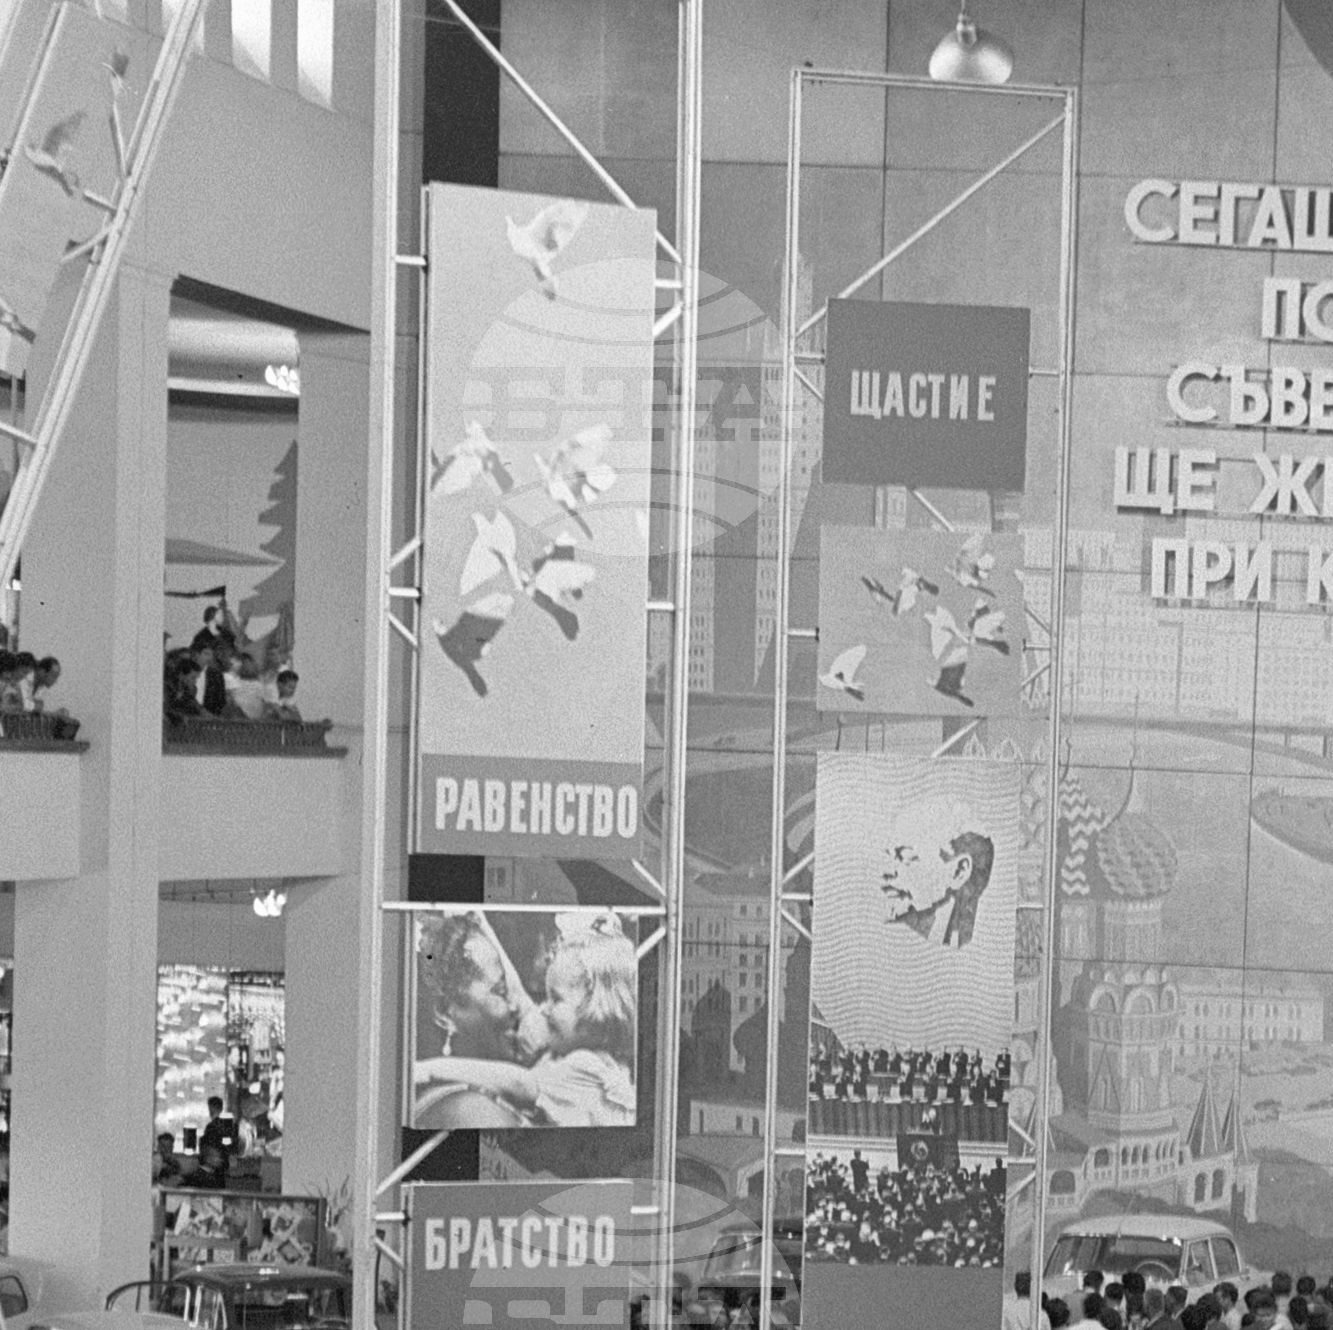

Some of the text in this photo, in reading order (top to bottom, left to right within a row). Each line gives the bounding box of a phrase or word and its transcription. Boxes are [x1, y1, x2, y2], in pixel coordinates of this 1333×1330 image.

[850, 369, 996, 422] ЩАСТИЕ
[1114, 446, 1217, 515] ЩЕ
[1151, 537, 1273, 601] ПРИ
[434, 776, 639, 838] РАВЕНСТВО
[424, 1214, 616, 1271] БРАТСТВО
